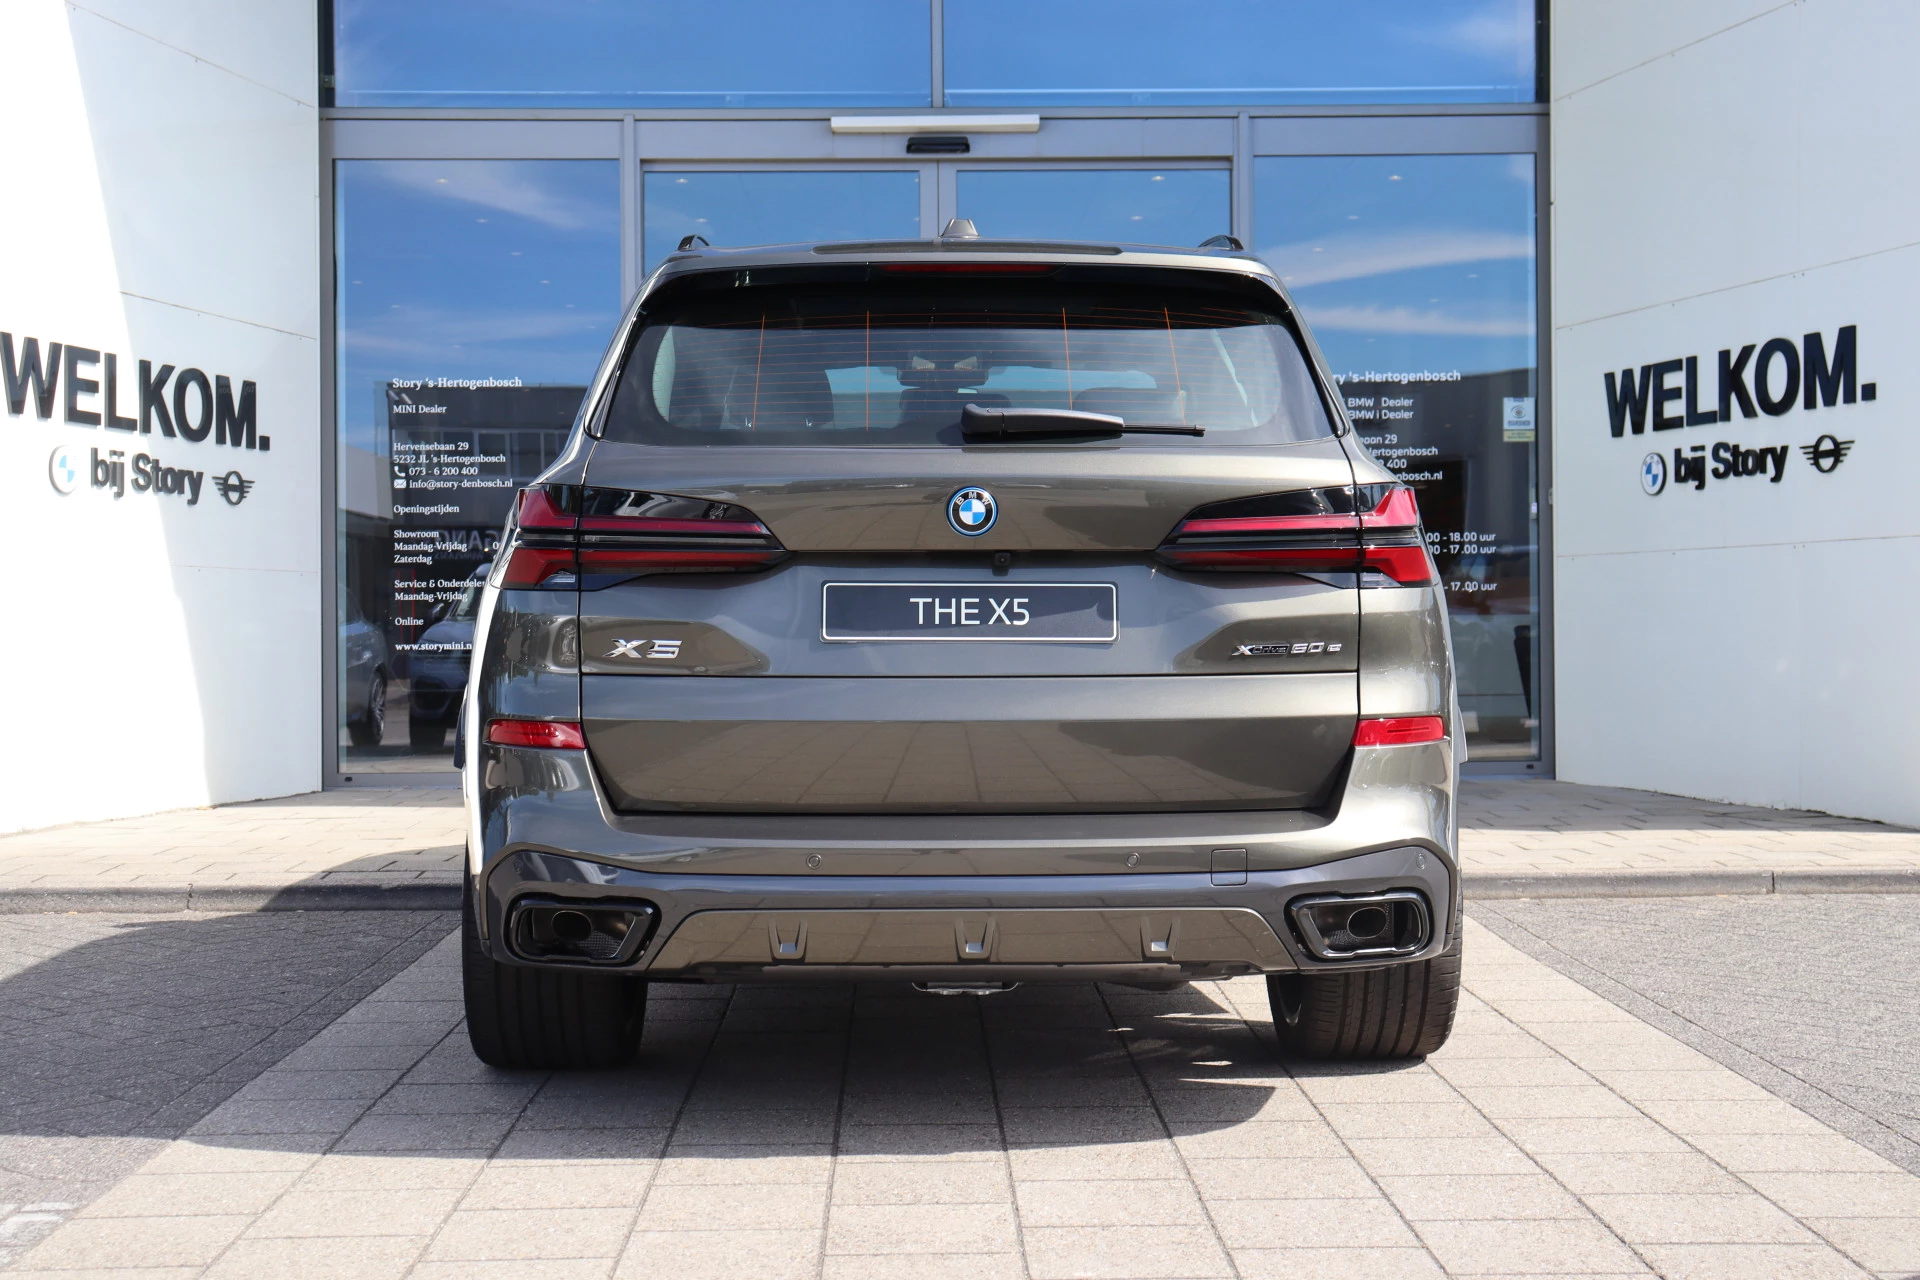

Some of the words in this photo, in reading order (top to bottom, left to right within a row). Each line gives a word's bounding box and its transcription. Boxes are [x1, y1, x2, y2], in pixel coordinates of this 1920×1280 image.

[392, 377, 423, 390] Story
[1332, 373, 1346, 385] ry
[1604, 324, 1877, 438] WELKOM.
[0, 331, 271, 451] WELKOM.
[1348, 398, 1374, 407] BMW
[1381, 398, 1414, 407] Dealer
[393, 405, 416, 413] MINI
[418, 404, 448, 413] Dealer
[1348, 410, 1374, 419] BMW
[1376, 410, 1380, 419] i
[1382, 410, 1414, 419] Dealer
[1384, 434, 1398, 444] 29
[393, 442, 455, 451] Hervensebaan
[457, 442, 469, 450] 29
[1369, 446, 1438, 457] ertogenbosch
[393, 454, 416, 463] 5232
[417, 454, 429, 465] JL
[1387, 459, 1407, 468] 400
[1674, 445, 1706, 490] bij
[1711, 441, 1790, 483] Story
[90, 447, 125, 500] bij
[131, 452, 204, 506] Story
[408, 467, 426, 476] 073
[434, 467, 440, 476] 6
[442, 467, 459, 475] 200
[461, 467, 478, 475] 400
[409, 479, 513, 490] info@story-denbosch.nl
[955, 491, 991, 506] BMW
[393, 504, 460, 515] Openingstijden
[394, 530, 439, 538] Showroom
[1449, 532, 1477, 542] 18.00
[1479, 533, 1496, 542] uur
[394, 542, 467, 553] Maandag-Vrijdag
[1480, 546, 1496, 554] uur
[394, 554, 432, 565] Zaterdag
[394, 579, 427, 588] Service
[429, 579, 435, 588] &
[1480, 583, 1497, 591] uur
[395, 592, 468, 602] Maandag-Vrijdag
[910, 598, 980, 625] THE
[987, 598, 1030, 625] X5
[395, 617, 424, 626] Online
[395, 642, 473, 653] www.storymini.n
[602, 638, 682, 658] X5
